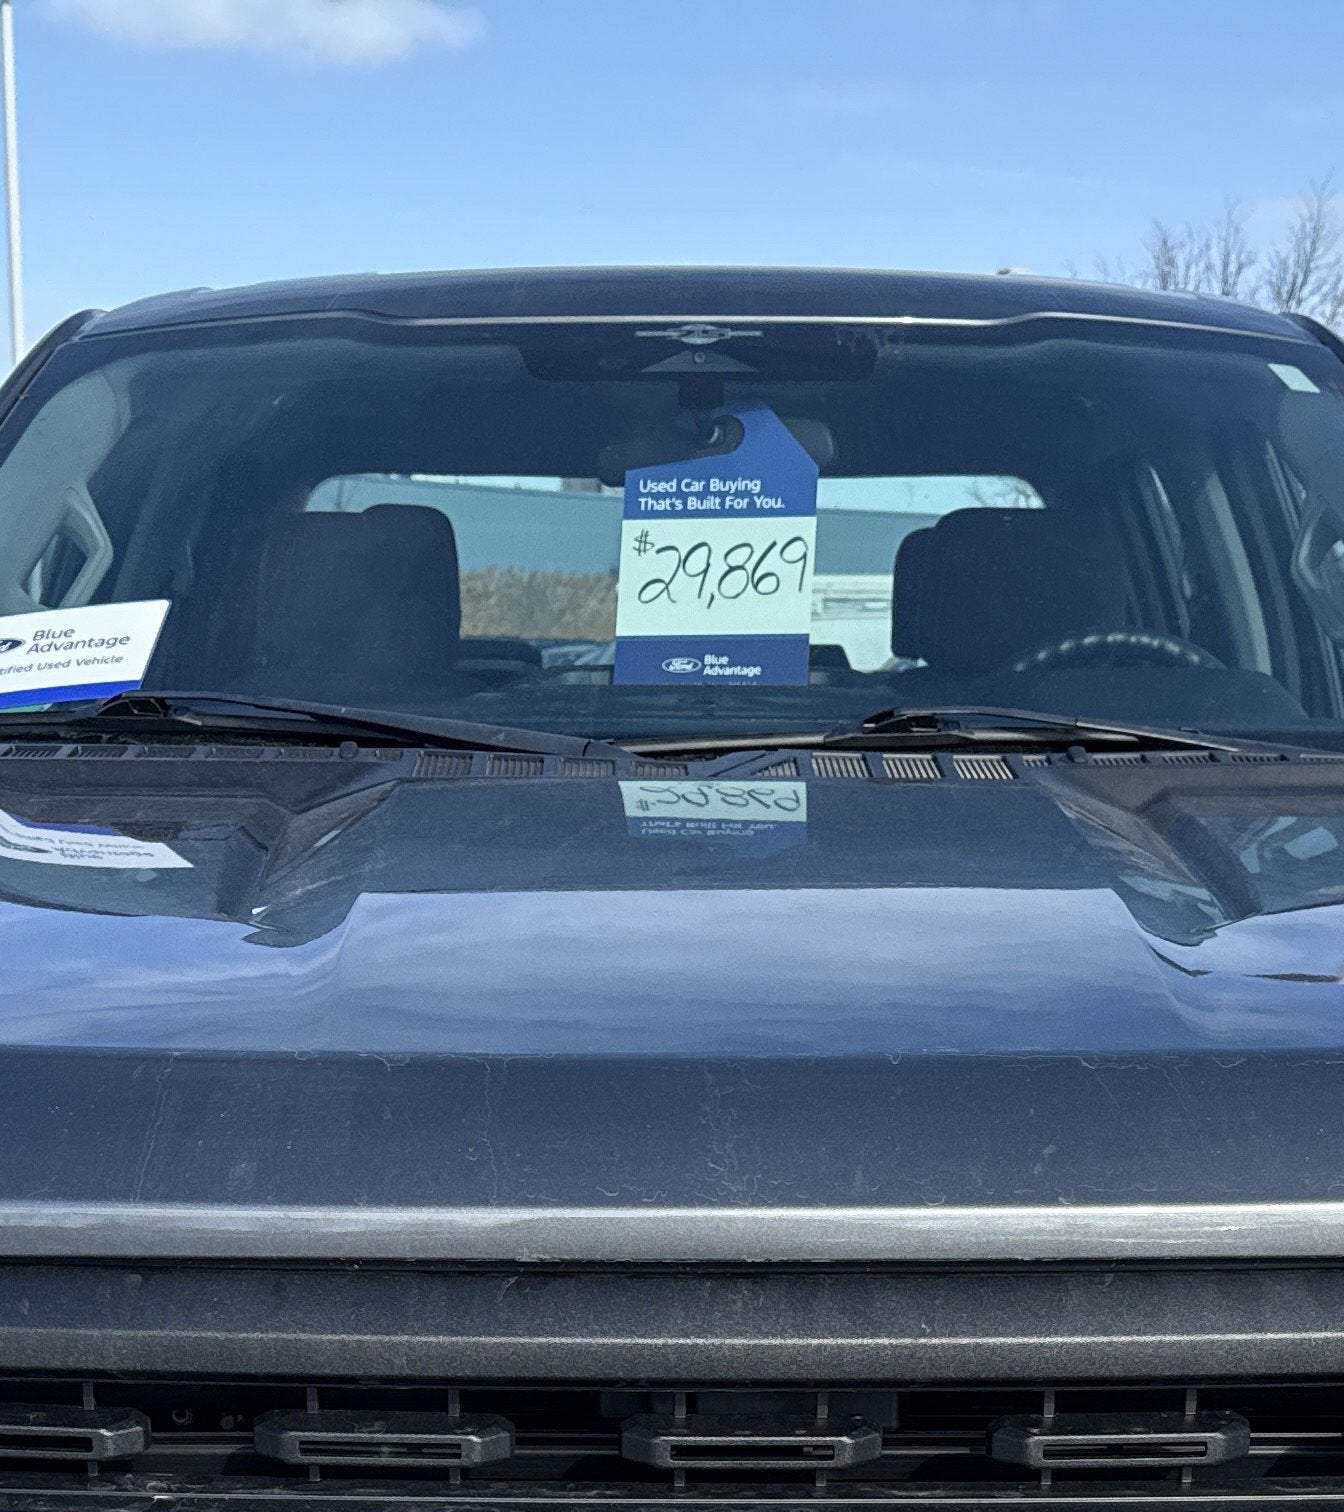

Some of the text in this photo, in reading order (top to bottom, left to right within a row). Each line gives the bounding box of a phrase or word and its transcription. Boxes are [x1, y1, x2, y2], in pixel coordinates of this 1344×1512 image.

[639, 476, 762, 494] Used Car Buying
[638, 495, 786, 511] That's Built For You.
[32, 627, 76, 641] Blue
[25, 634, 131, 656] Advantage
[36, 659, 72, 672] Used
[75, 654, 125, 667] Vehicle
[703, 653, 730, 665] Blue
[702, 665, 762, 678] Advantage
